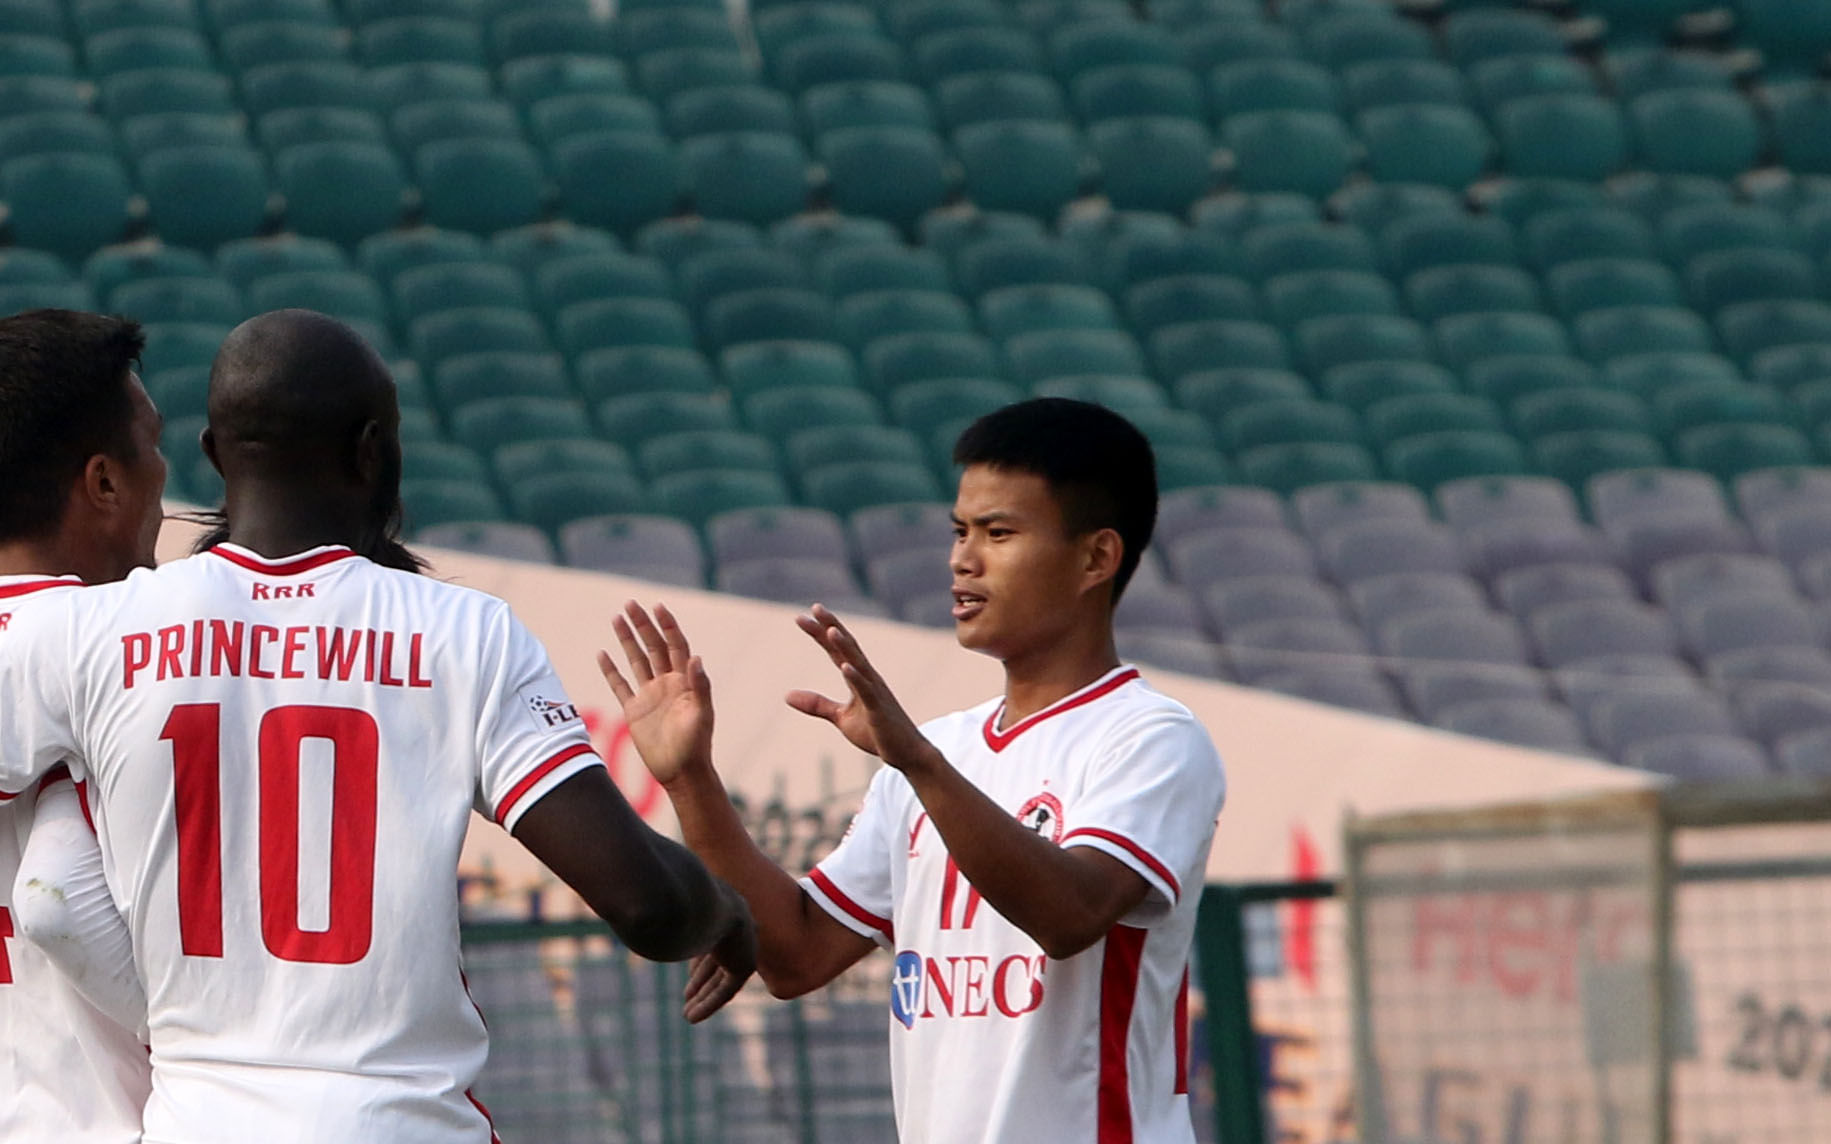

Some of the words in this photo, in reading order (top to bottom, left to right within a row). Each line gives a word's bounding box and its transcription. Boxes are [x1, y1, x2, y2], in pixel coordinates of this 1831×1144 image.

[252, 582, 315, 600] RRR
[121, 619, 432, 689] PRINCEWILL
[159, 703, 379, 964] 10
[920, 953, 1047, 1019] NECS
